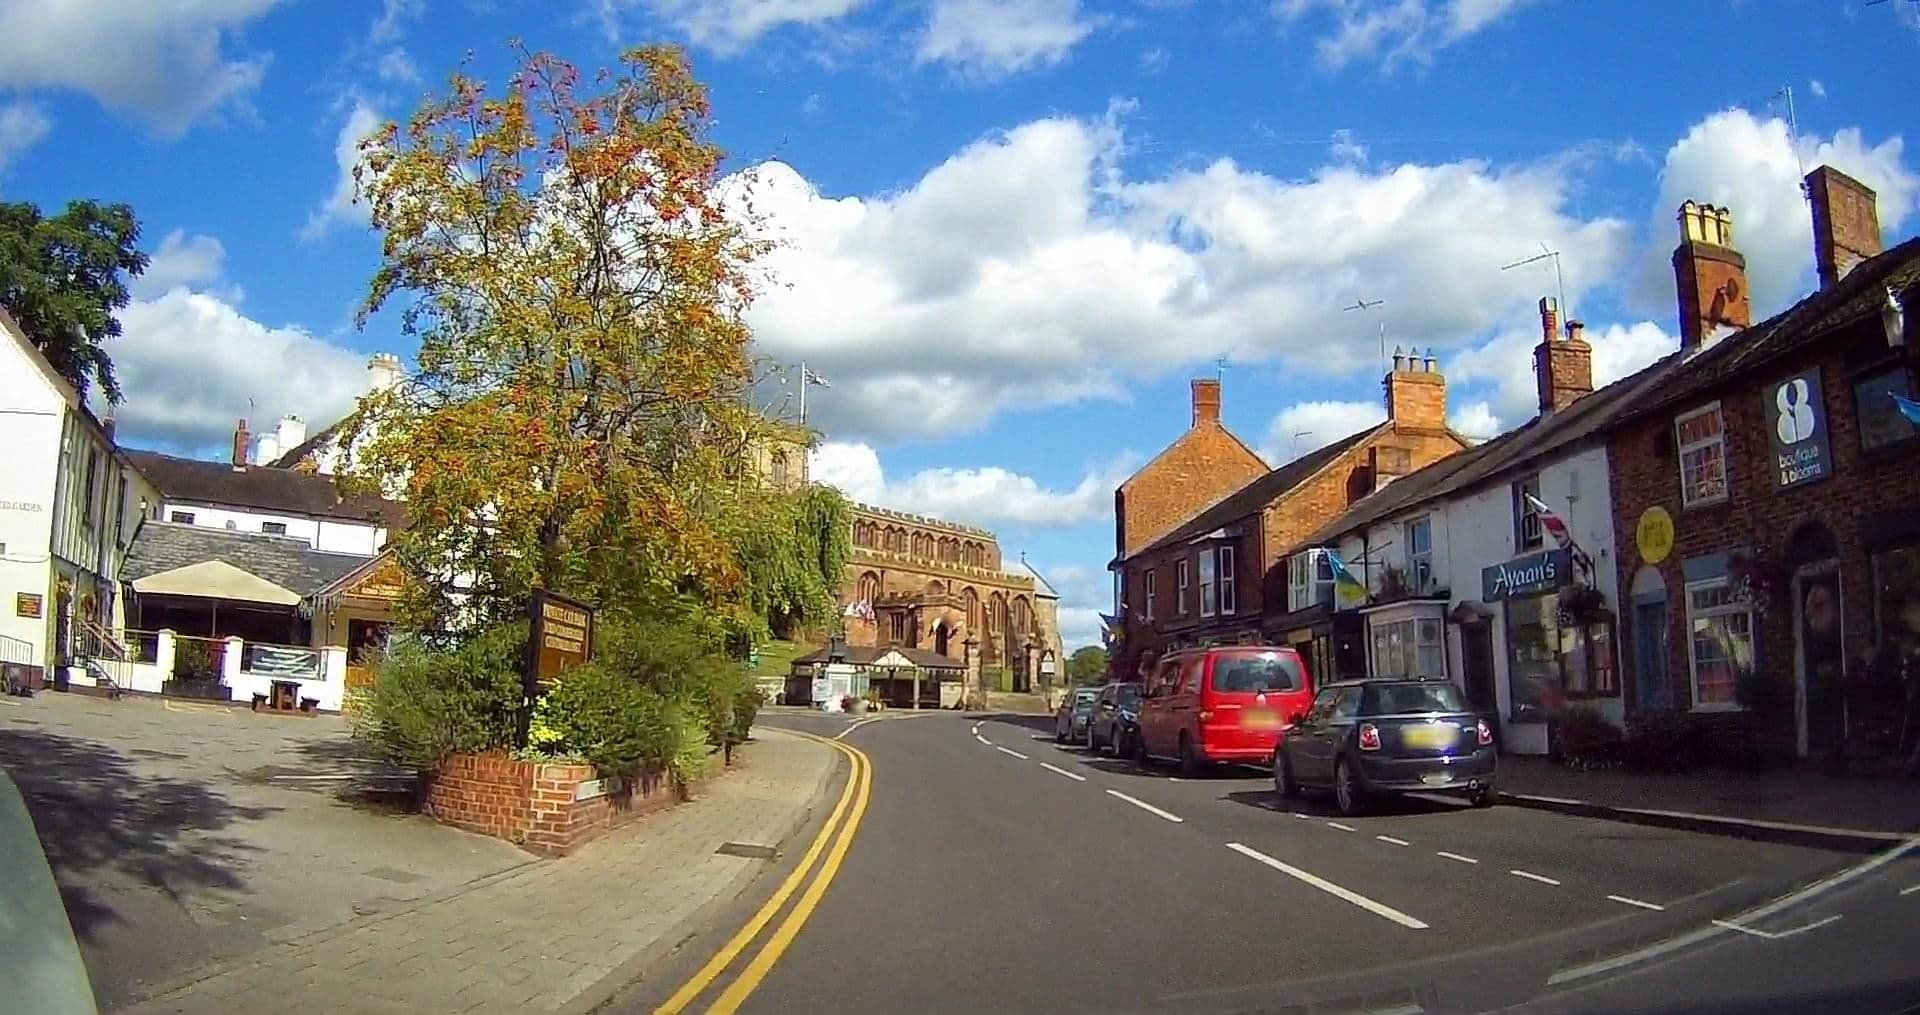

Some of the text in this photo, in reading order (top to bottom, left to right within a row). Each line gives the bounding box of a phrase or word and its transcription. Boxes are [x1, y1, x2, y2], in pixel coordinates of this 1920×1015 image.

[1777, 379, 1815, 445] 8
[1779, 445, 1819, 469] boutique
[1789, 463, 1822, 483] blooms
[1493, 552, 1557, 596] Ayaan's
